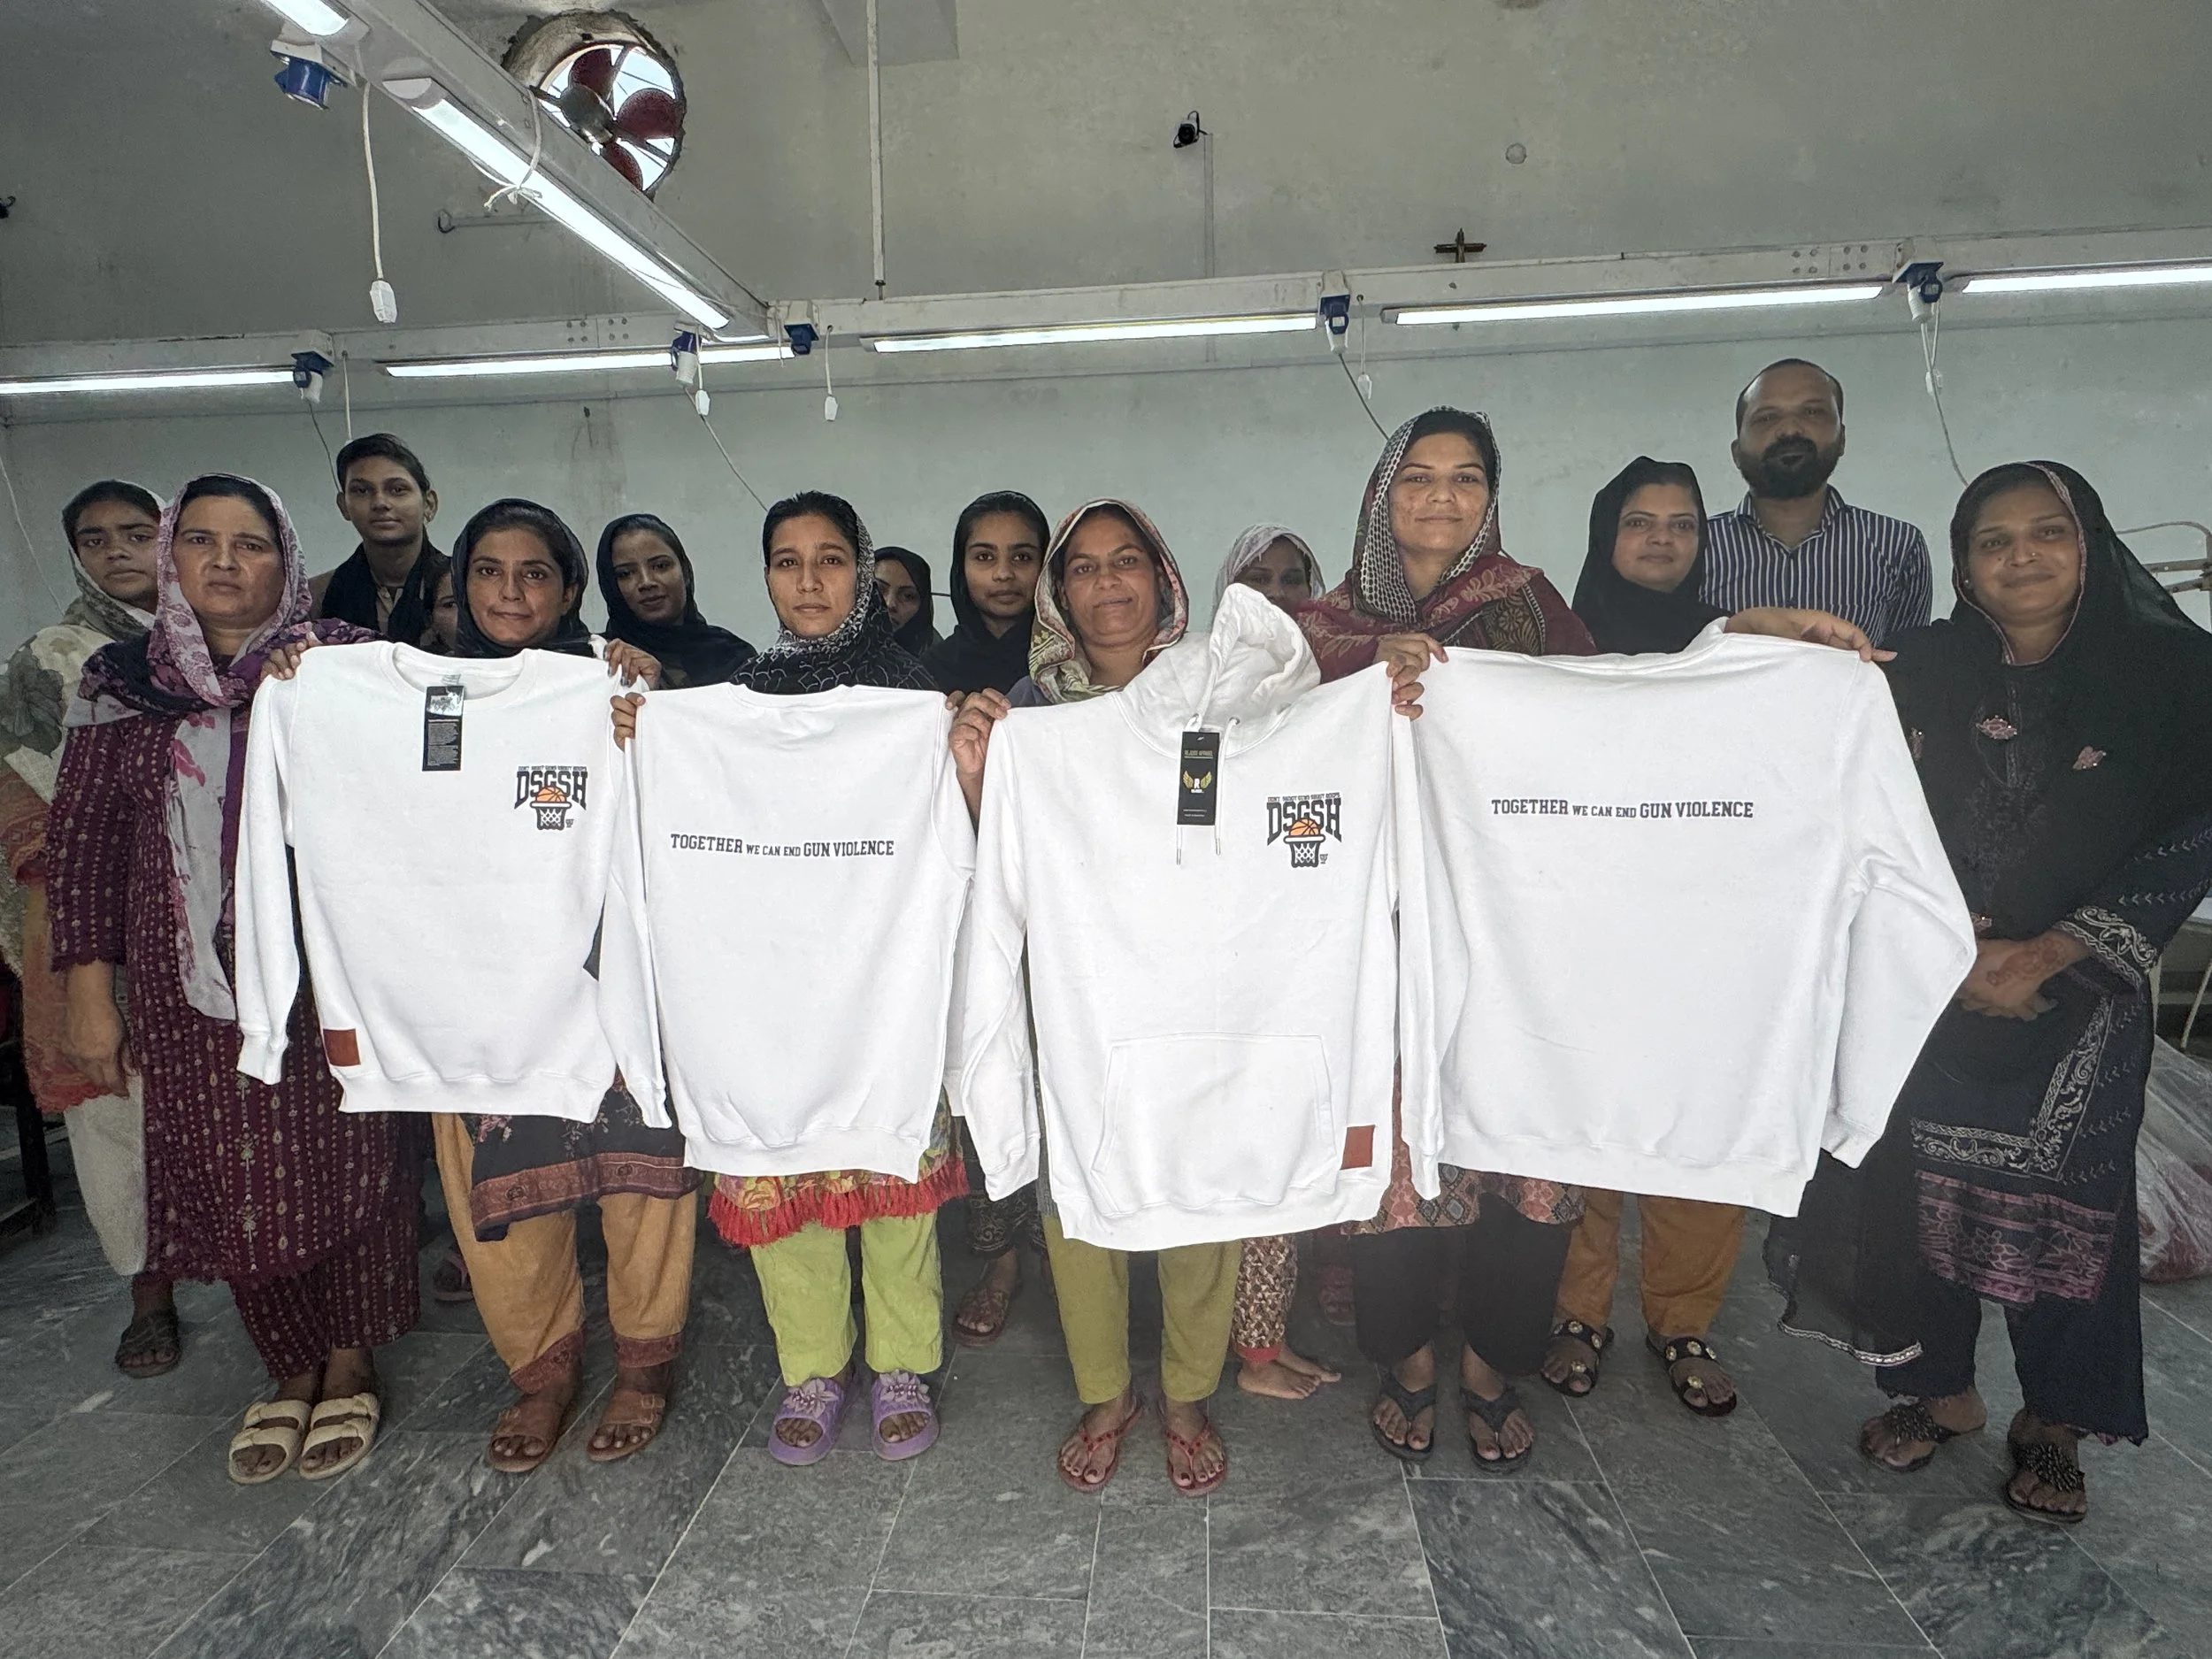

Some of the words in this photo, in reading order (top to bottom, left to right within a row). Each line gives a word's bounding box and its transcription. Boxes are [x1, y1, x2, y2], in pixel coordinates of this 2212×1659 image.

[1491, 799, 1569, 815] TOGETHER
[1571, 805, 1588, 817] WE
[1591, 805, 1613, 818] CAN
[1616, 806, 1637, 818] END
[1640, 802, 1672, 818] GUN
[1675, 801, 1754, 818] VIOLENCE
[670, 833, 743, 854] TOGETHER
[746, 843, 761, 855] WE
[762, 845, 781, 856] CAN
[783, 846, 801, 857] END
[803, 842, 831, 857] GUN
[833, 840, 895, 857] VIOLENCE
